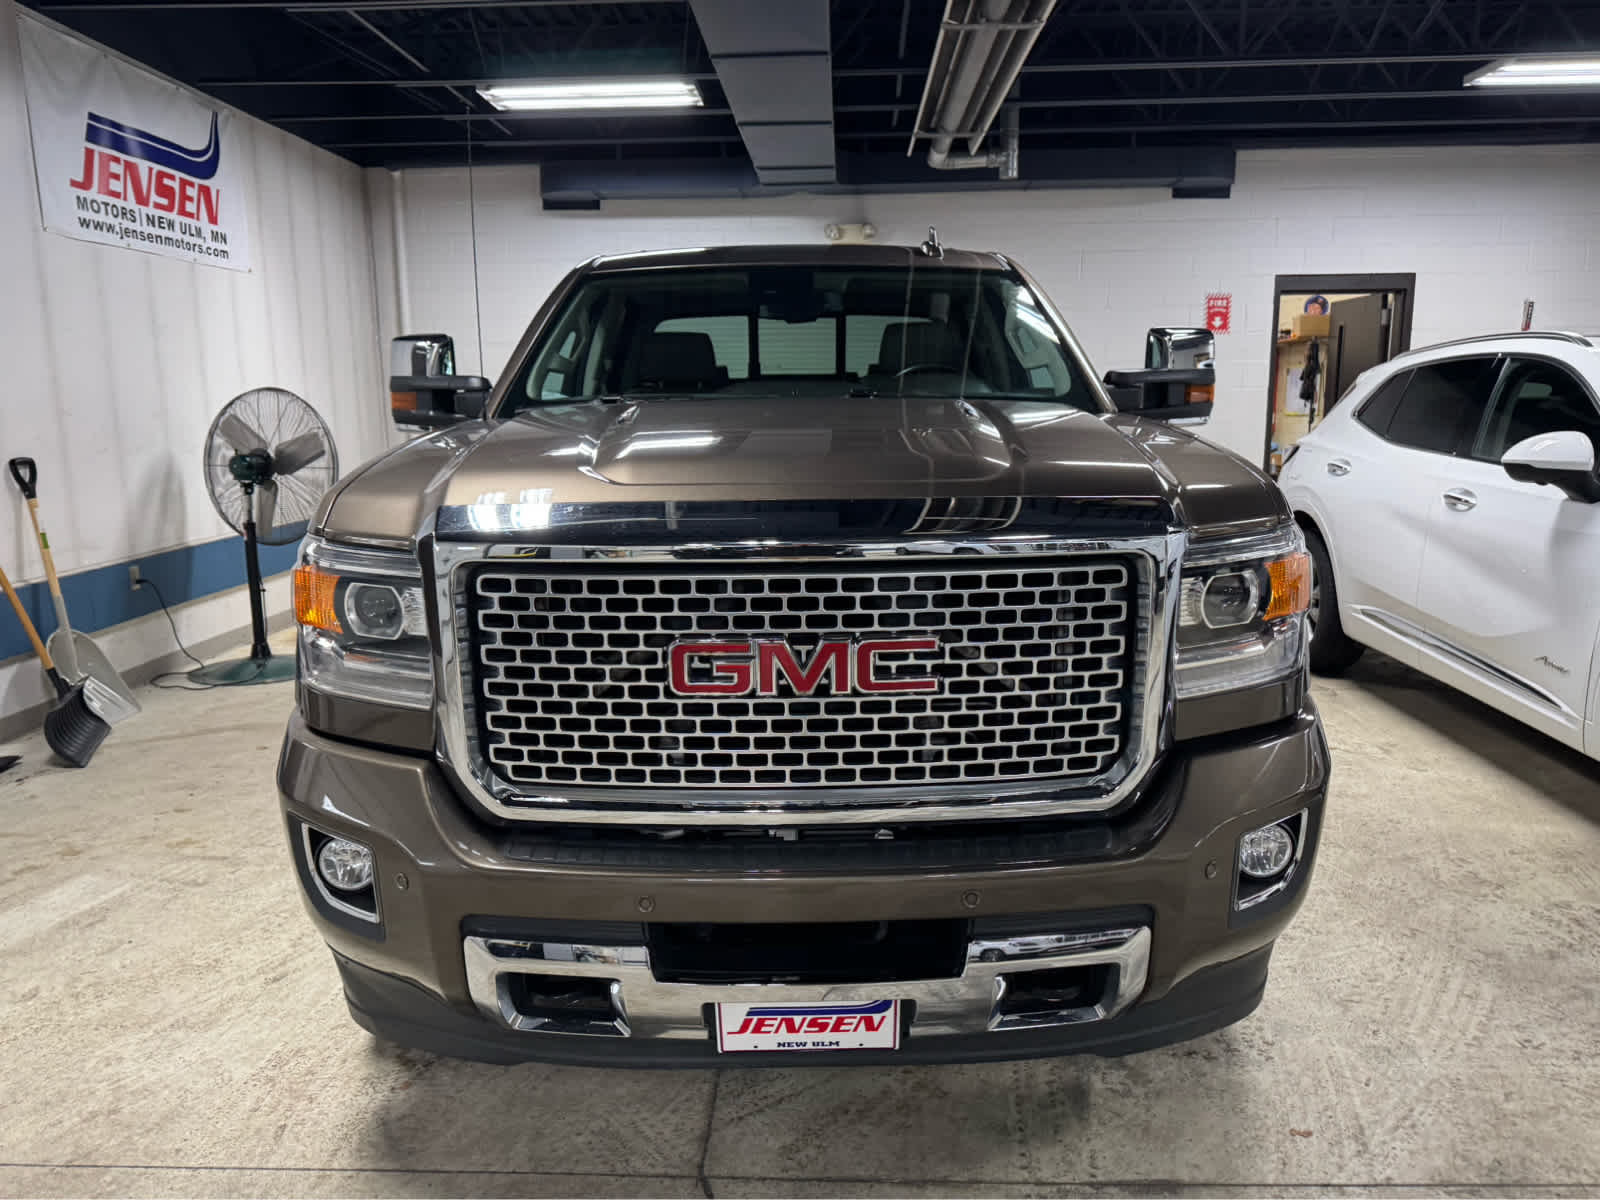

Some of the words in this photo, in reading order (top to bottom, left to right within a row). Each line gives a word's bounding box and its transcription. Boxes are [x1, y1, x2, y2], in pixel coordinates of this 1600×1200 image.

[69, 146, 220, 226] JENSEN
[75, 195, 137, 223] MOTORS
[145, 213, 175, 232] NEW
[179, 221, 206, 243] ULM,
[210, 229, 228, 245] MN
[78, 216, 230, 259] www.jensenmotors.com
[668, 637, 940, 697] GMC
[727, 1015, 887, 1035] JENSEN
